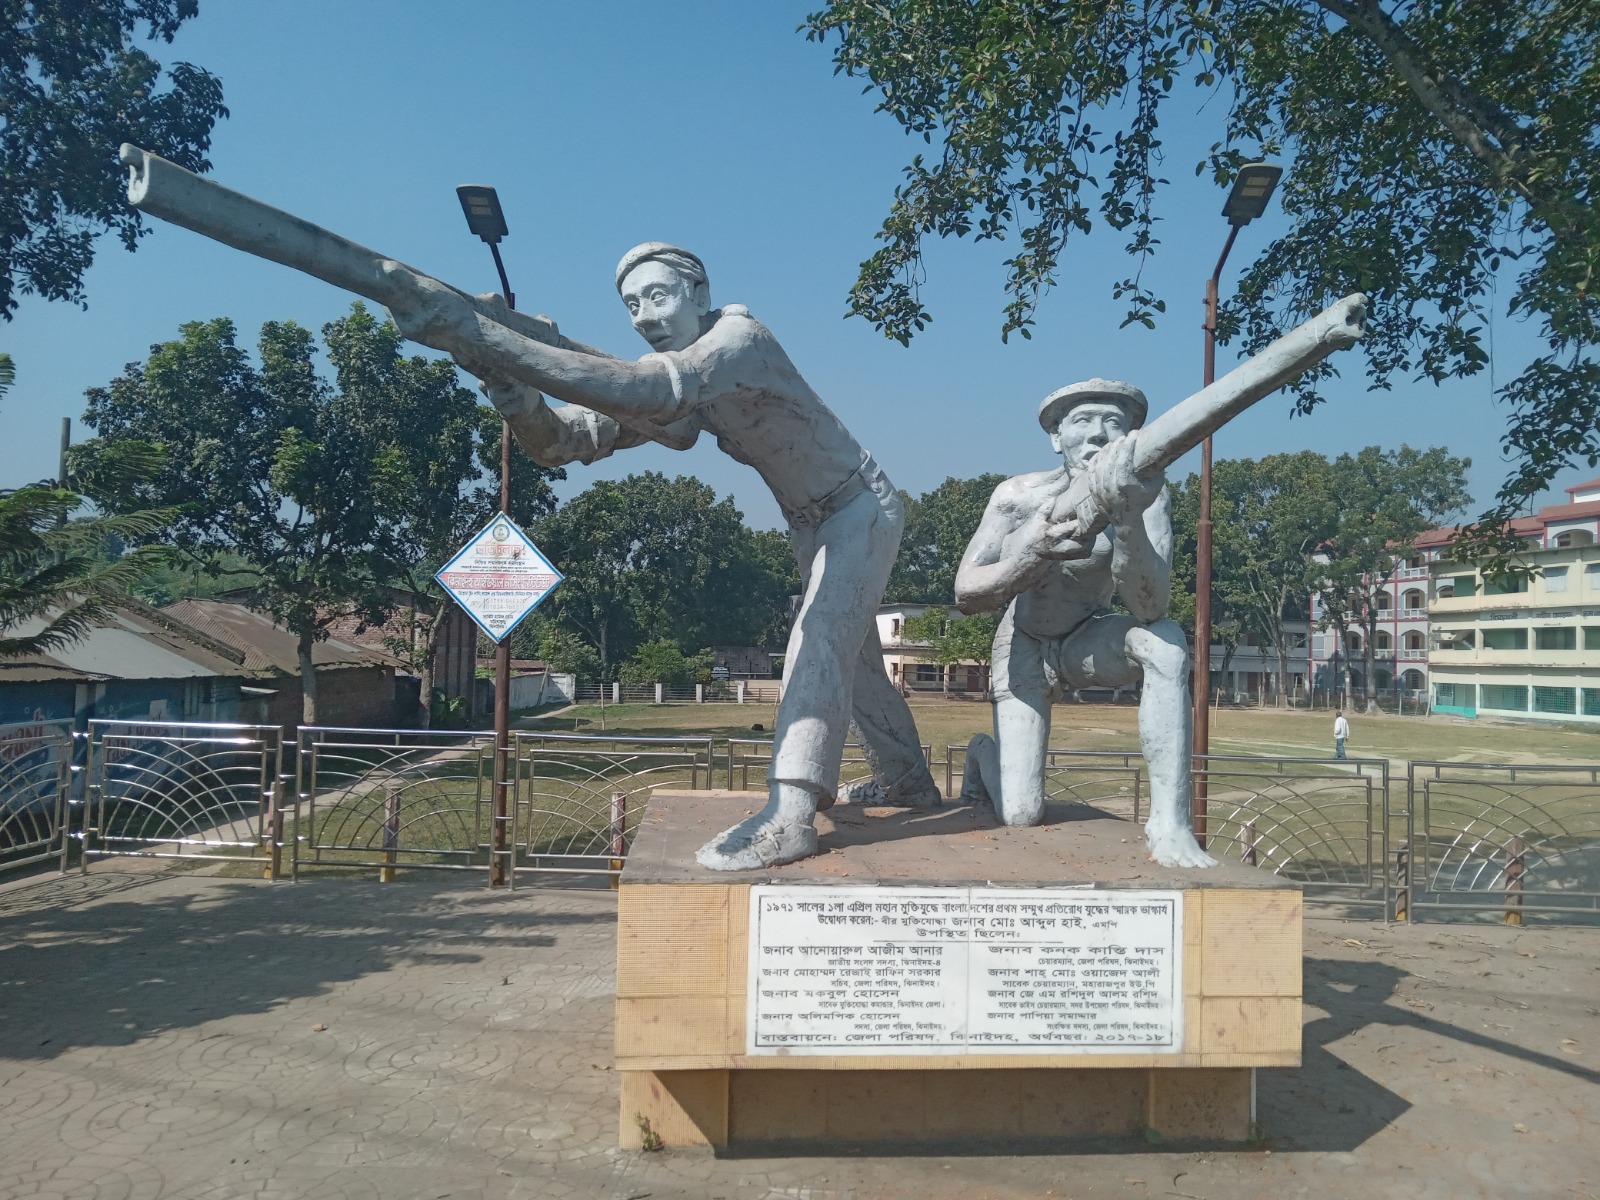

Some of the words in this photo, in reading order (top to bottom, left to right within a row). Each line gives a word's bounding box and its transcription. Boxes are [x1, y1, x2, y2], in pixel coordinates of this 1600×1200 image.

[767, 903, 794, 912] ১৯৭১
[796, 902, 826, 912] সালের
[847, 901, 873, 912] এপ্রিল
[875, 903, 899, 913] মহান
[900, 901, 940, 915] মুক্তিযুদ্ধে
[996, 904, 1018, 913] প্রথম
[1045, 903, 1083, 914] প্রতিরোধ
[1084, 905, 1110, 917] যুদ্ধের
[881, 915, 898, 925] বীর
[901, 916, 946, 926] মুক্তিযোদ্ধা
[991, 917, 1016, 927] মোঃ
[763, 945, 795, 955] জনাব
[798, 945, 863, 956] আনোয়ারুল
[867, 943, 906, 955] আজীম
[909, 946, 944, 956] আনার
[988, 946, 1034, 954] জনাব
[1134, 947, 1166, 955] দাস
[1051, 969, 1076, 977] মোঃ
[1081, 969, 1128, 977] ওয়াজেদ
[1132, 967, 1161, 977] আলী
[762, 990, 799, 998] জনাব
[804, 990, 848, 1001] মকবুল
[852, 990, 901, 998] হোসেন
[987, 990, 1016, 998] জনাব
[1132, 988, 1159, 1000] রশিদ
